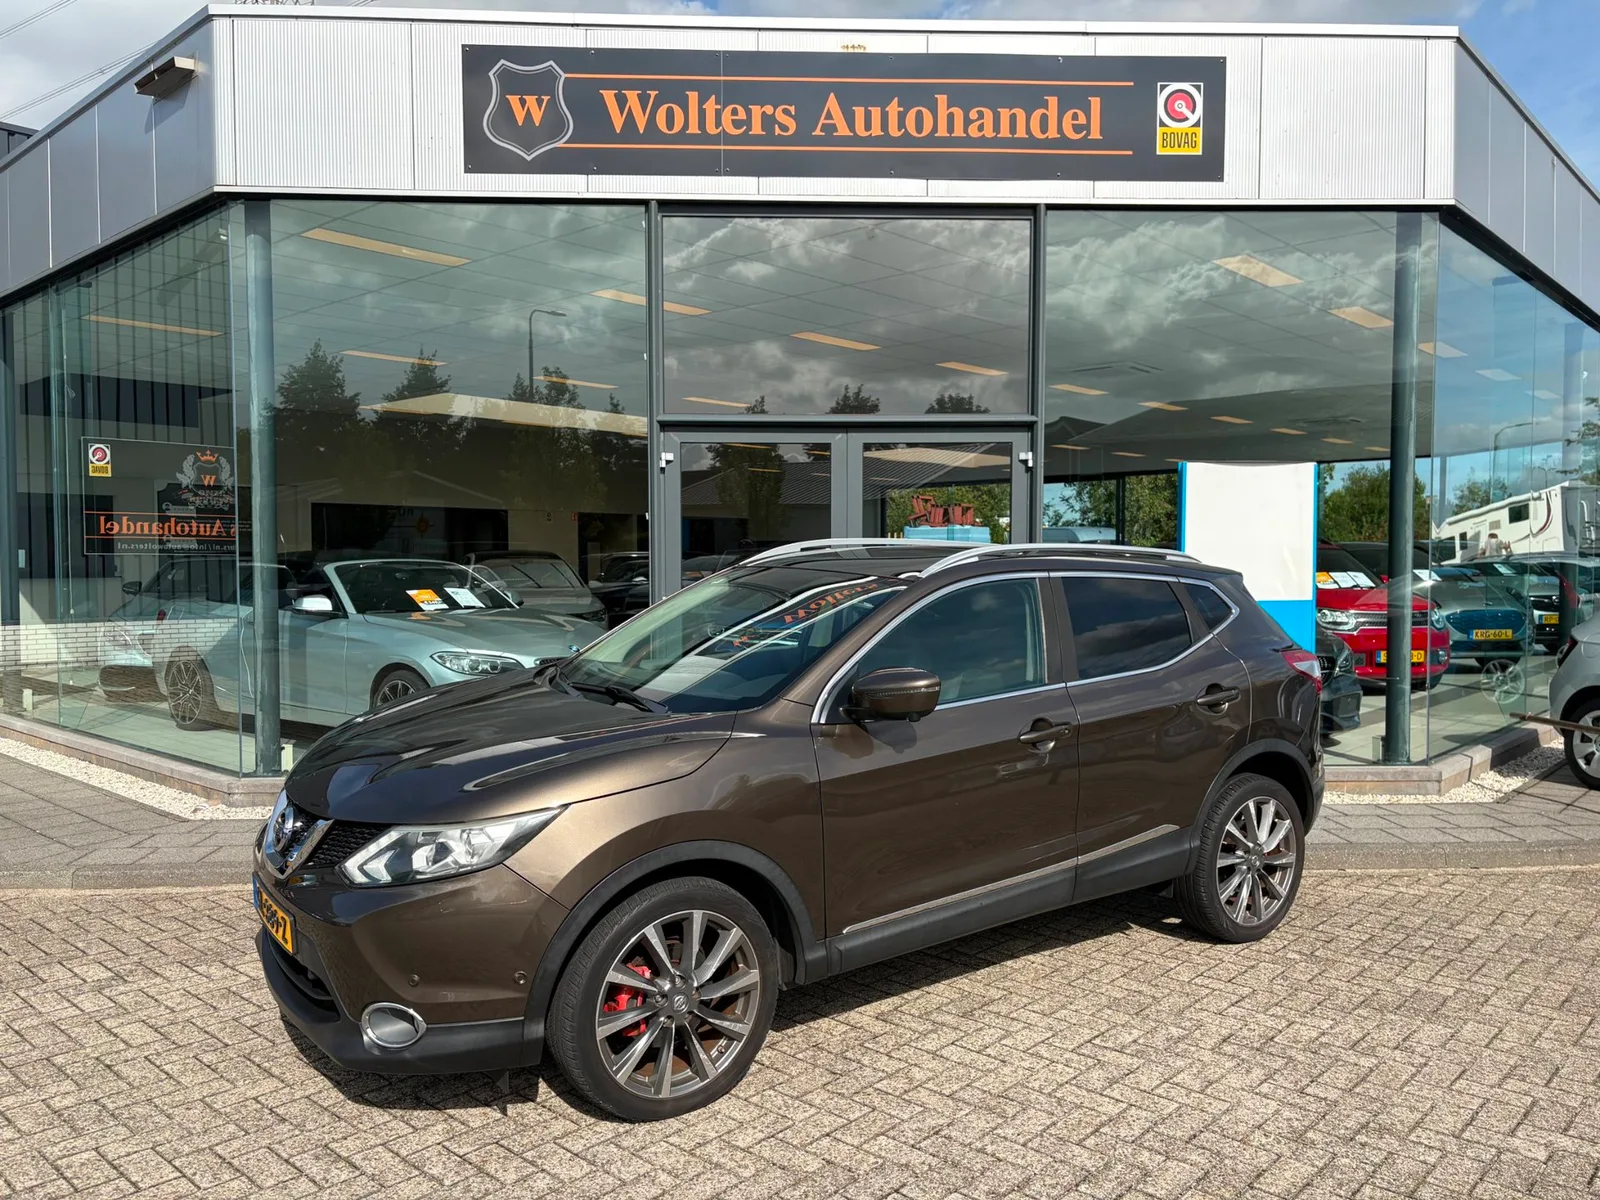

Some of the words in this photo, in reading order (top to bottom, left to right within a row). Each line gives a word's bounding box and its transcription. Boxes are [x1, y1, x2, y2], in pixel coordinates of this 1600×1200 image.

[505, 94, 551, 127] W
[599, 89, 798, 136] Wolters
[811, 92, 1104, 140] Autohandel
[1161, 131, 1198, 149] BOVAG
